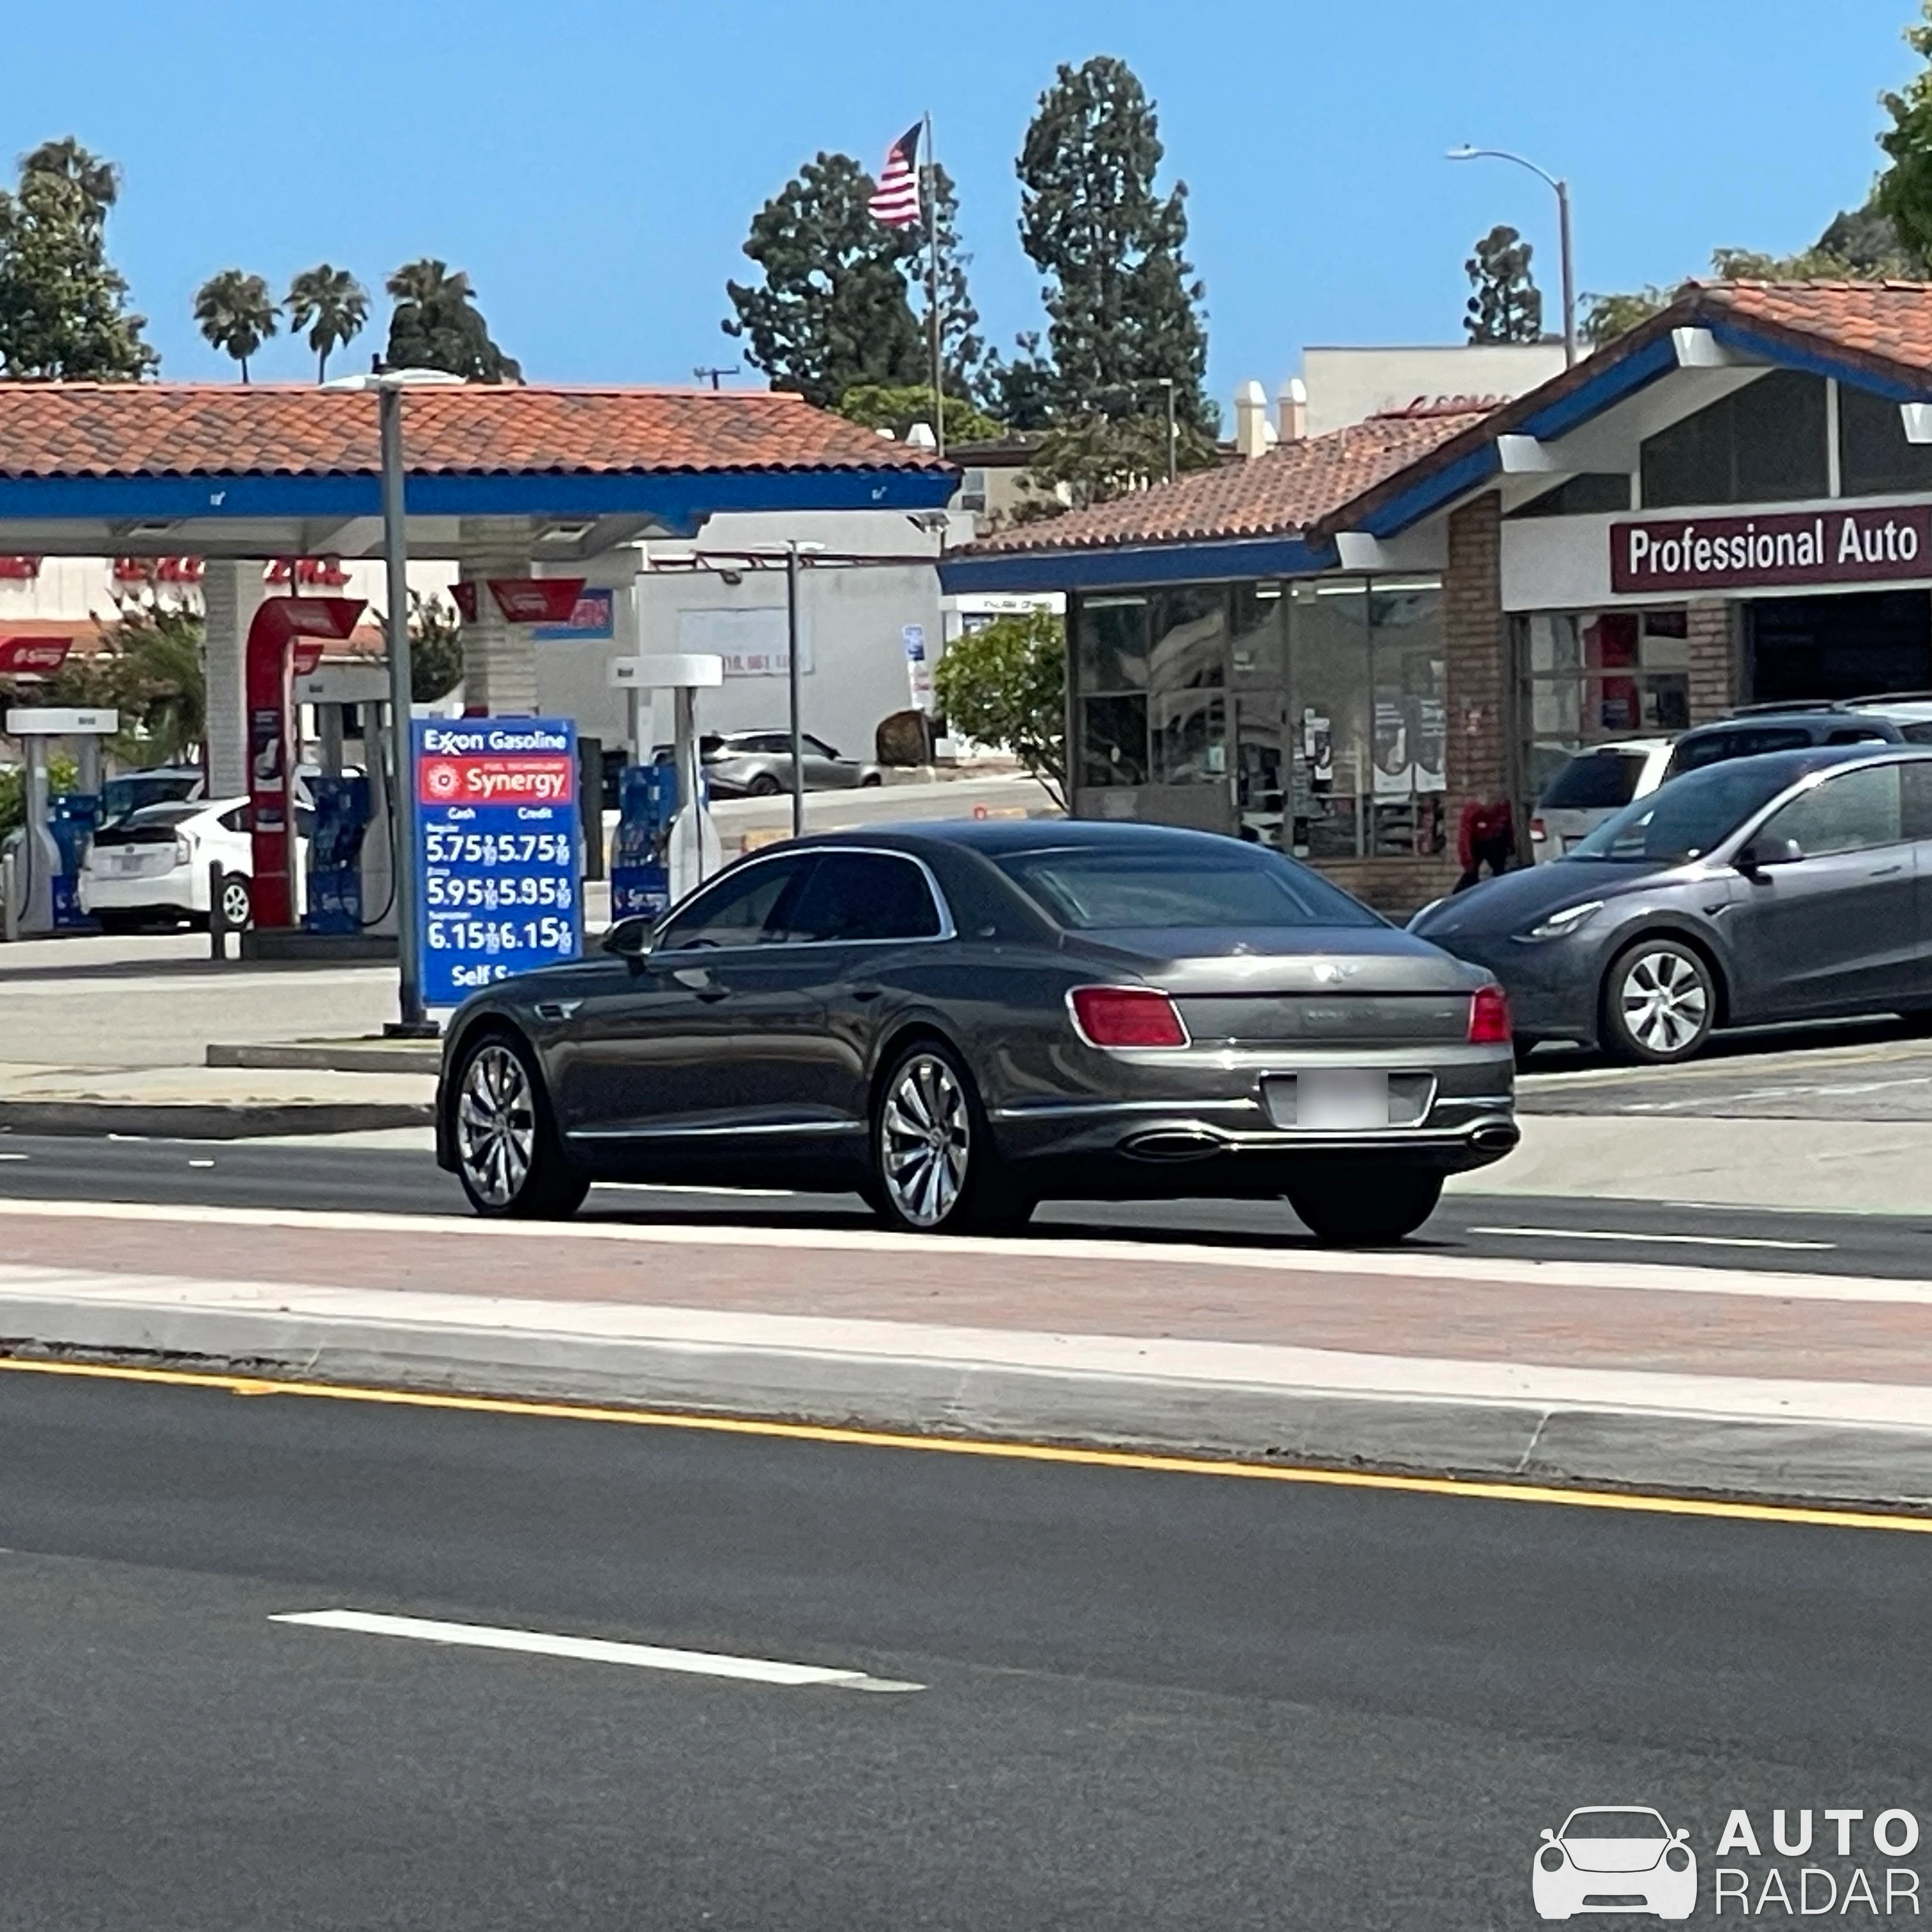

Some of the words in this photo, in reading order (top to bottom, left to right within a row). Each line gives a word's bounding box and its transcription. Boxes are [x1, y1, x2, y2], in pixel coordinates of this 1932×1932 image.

[1629, 518, 1823, 574] Professional
[1837, 518, 1918, 564] Auto
[424, 729, 484, 755] Exxon
[489, 730, 566, 750] Gasoline
[466, 768, 565, 798] Synergy
[447, 807, 476, 820] Cash
[518, 807, 553, 820] Credit
[427, 835, 482, 862] 5.75
[498, 835, 555, 862] 5.75
[427, 878, 483, 906] 5.95
[429, 922, 486, 950] 6.15
[500, 917, 560, 949] 6.15
[452, 965, 491, 987] Self
